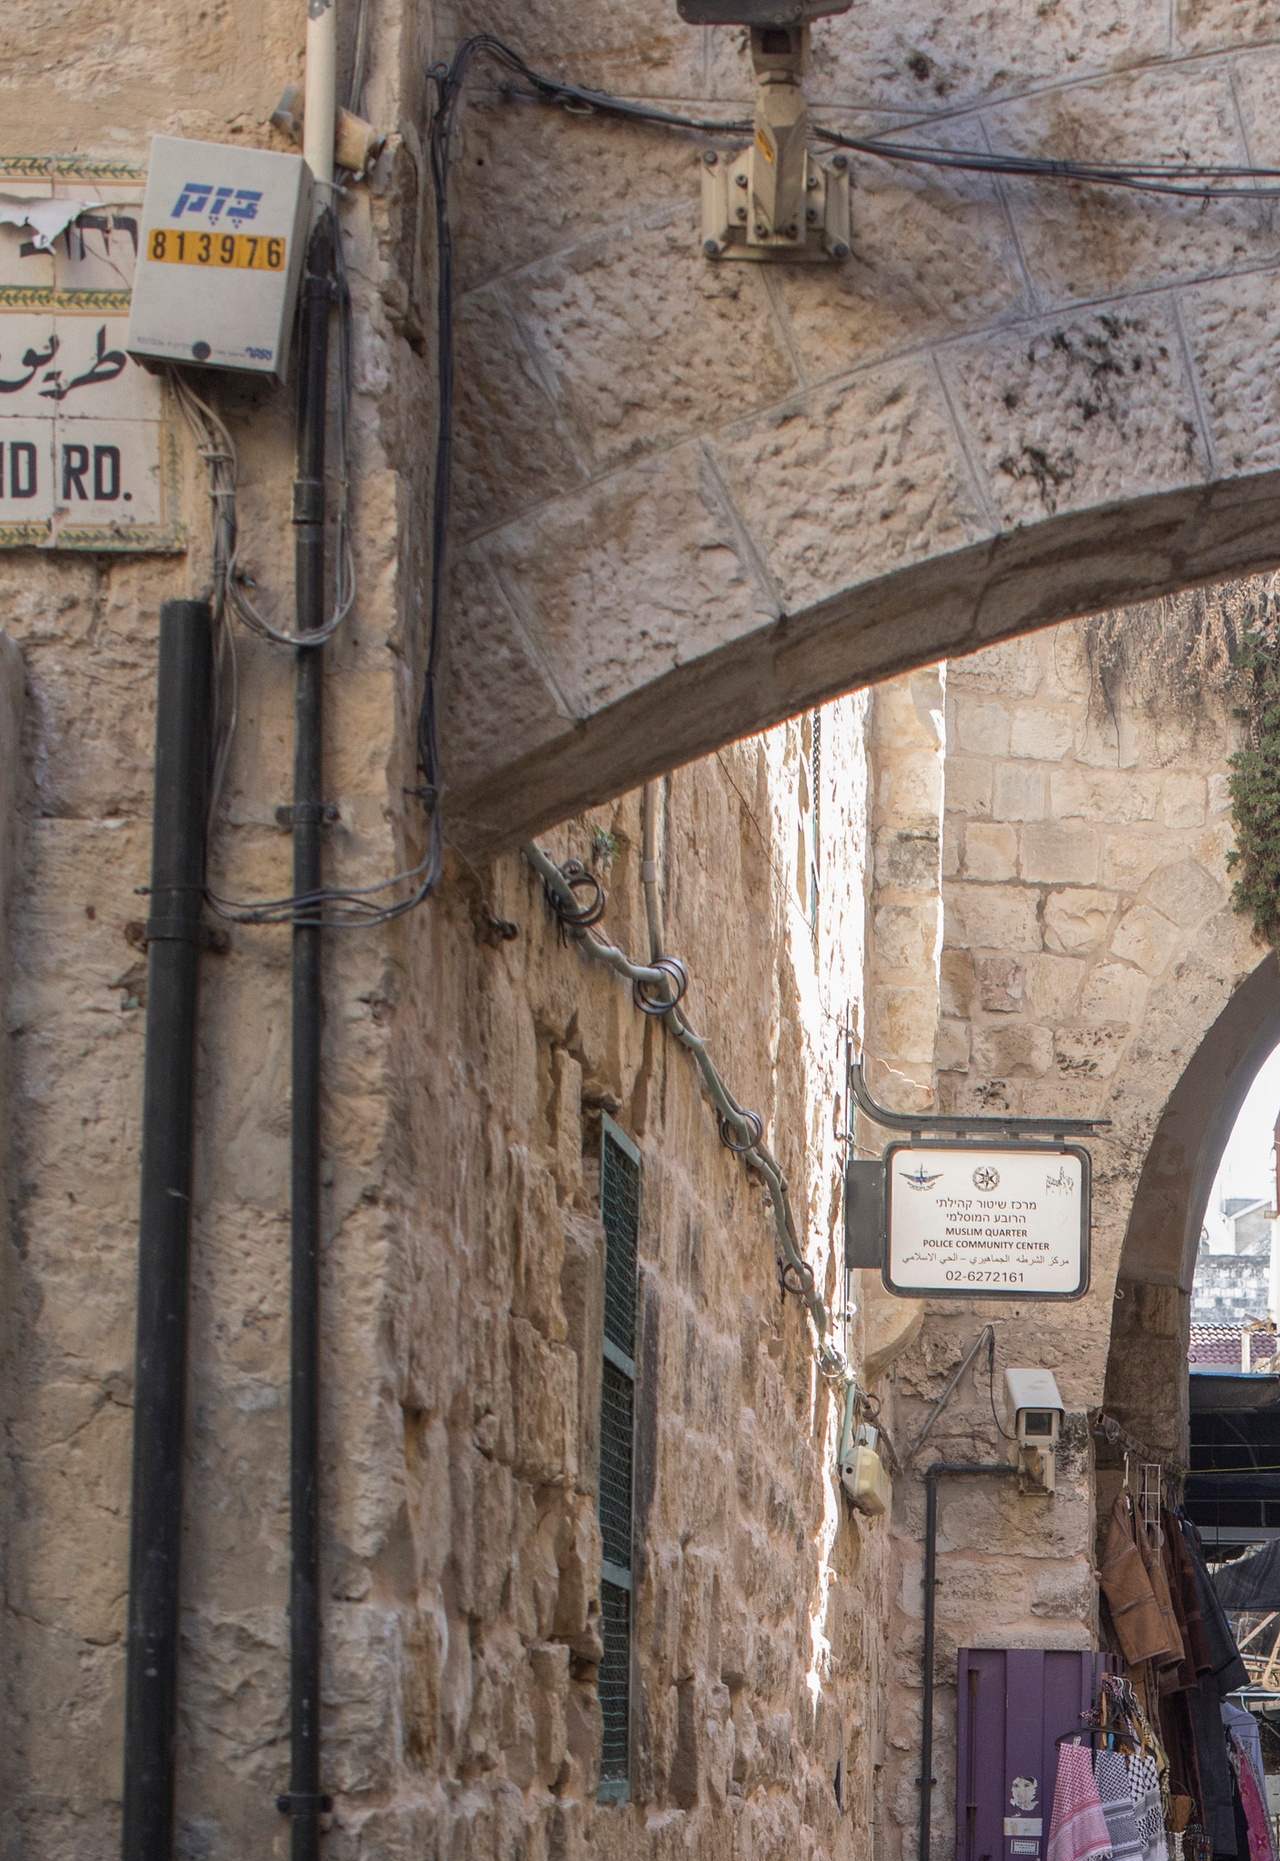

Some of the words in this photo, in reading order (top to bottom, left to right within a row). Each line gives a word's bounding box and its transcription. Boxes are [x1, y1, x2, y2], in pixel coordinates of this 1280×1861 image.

[153, 231, 281, 268] 813976
[62, 443, 132, 501] RD.
[936, 1197, 973, 1210] קהילתי
[976, 1200, 1007, 1209] שיטור
[1011, 1201, 1037, 1210] מרכז
[946, 1211, 990, 1222] המוסלמי
[994, 1214, 1026, 1223] הרובע
[945, 1227, 983, 1236] MUSLIM
[985, 1228, 1028, 1238] QUARTER
[923, 1239, 954, 1248] POLICE
[956, 1240, 1014, 1250] COMMUNITY
[1016, 1242, 1050, 1251] CENTER
[1048, 1253, 1070, 1267] مركز
[945, 1270, 1024, 1283] 02-6272161
